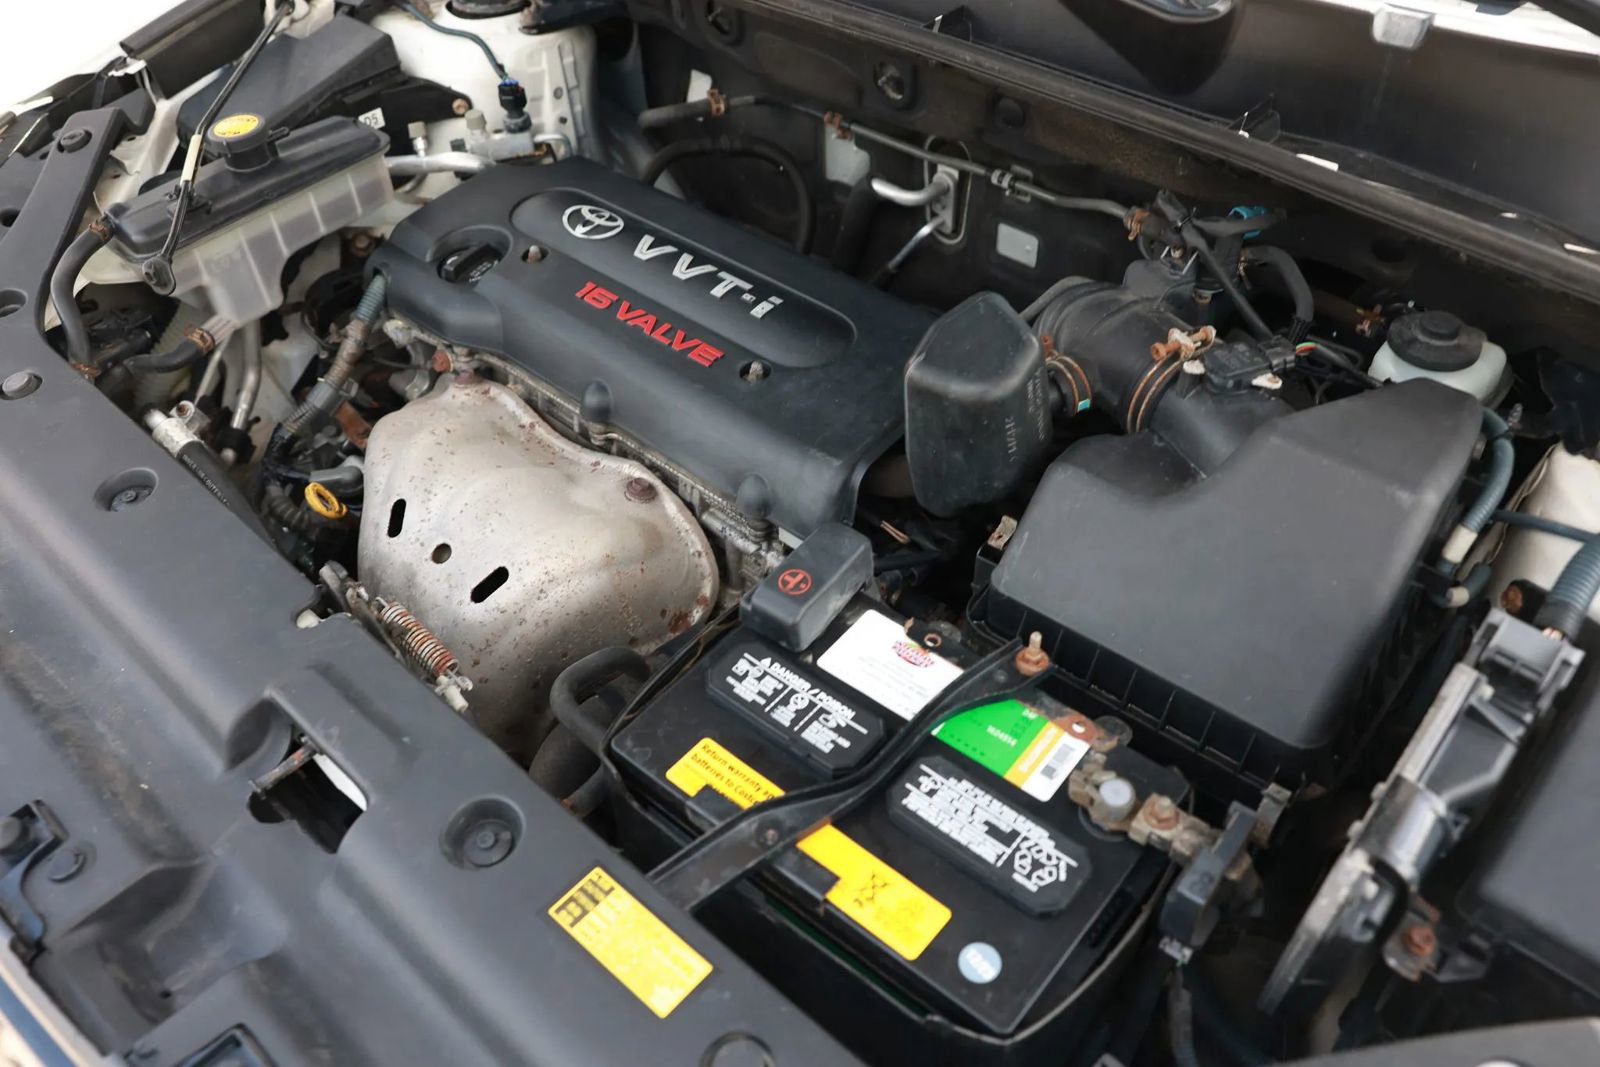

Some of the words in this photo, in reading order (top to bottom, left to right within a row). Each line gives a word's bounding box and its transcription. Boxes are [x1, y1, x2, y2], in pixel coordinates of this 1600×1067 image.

[575, 281, 619, 310] 16
[616, 301, 725, 367] VALVE
[770, 662, 812, 692] DANGER
[816, 692, 856, 720] POISON
[690, 752, 725, 781] batteries
[701, 743, 728, 766] Return
[728, 763, 762, 793] warranty
